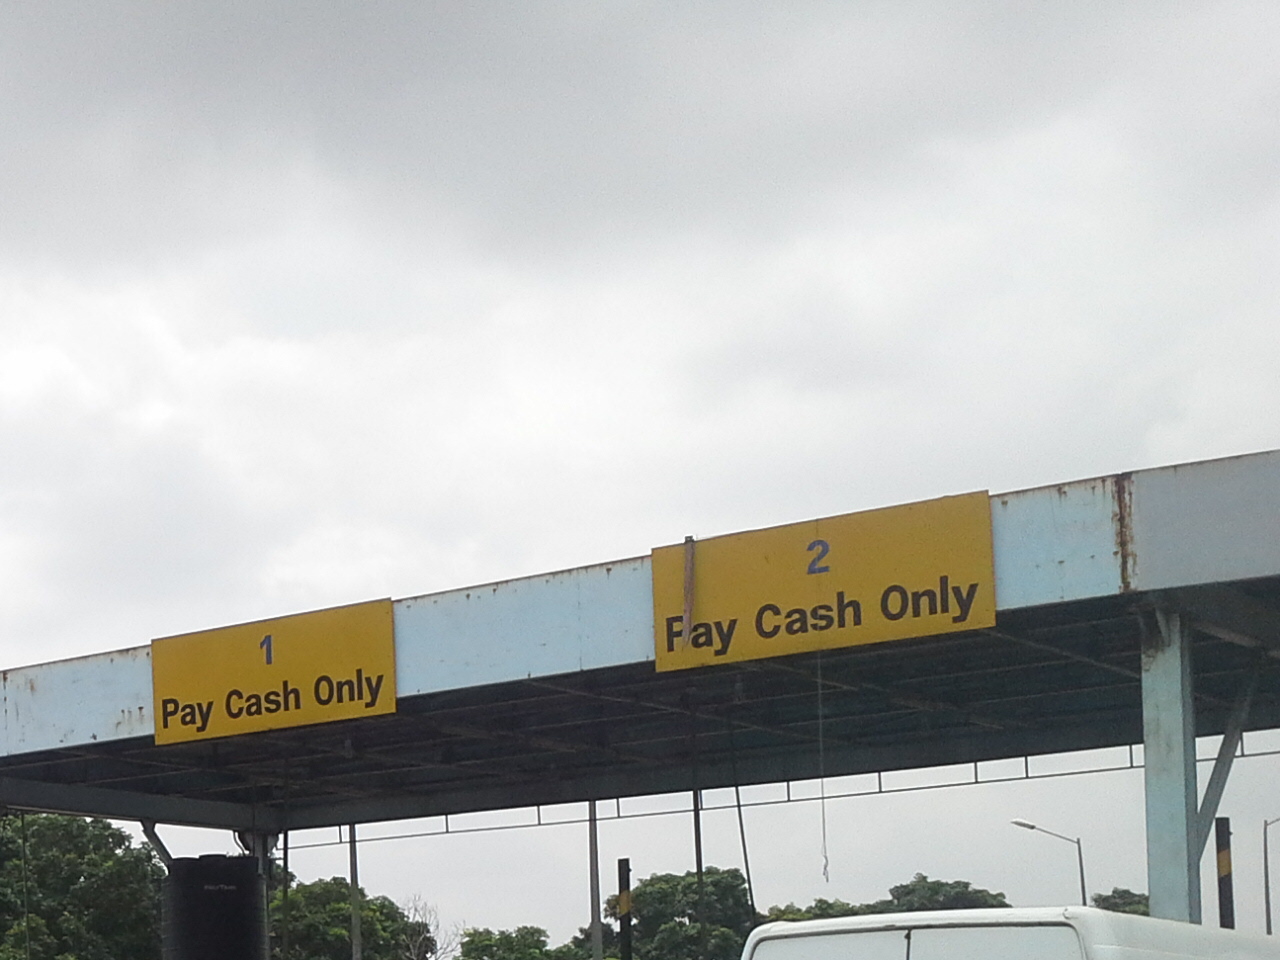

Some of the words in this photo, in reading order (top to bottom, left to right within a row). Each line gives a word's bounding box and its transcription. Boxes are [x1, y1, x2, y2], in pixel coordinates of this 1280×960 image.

[806, 539, 830, 575] 2
[666, 616, 738, 656] Pay
[755, 591, 862, 639] Cash
[881, 575, 979, 624] Only
[260, 635, 273, 665] 1
[162, 698, 214, 733] Pay
[225, 680, 301, 719] Cash
[314, 668, 384, 708] Only
